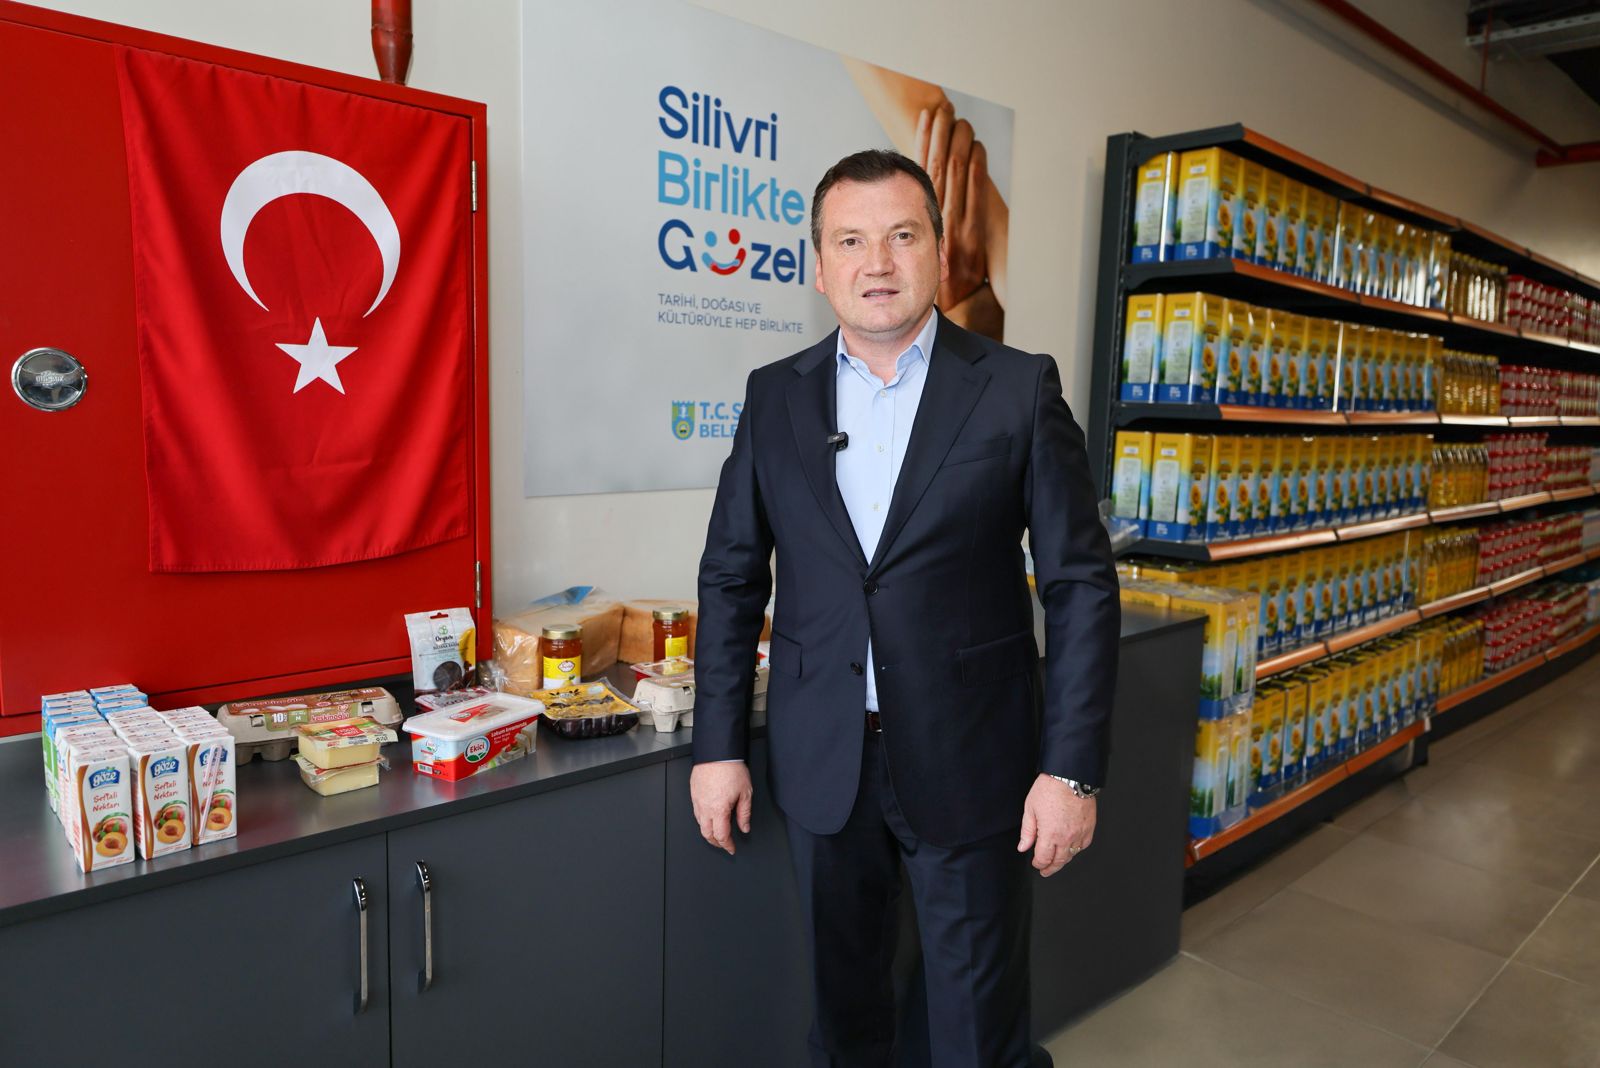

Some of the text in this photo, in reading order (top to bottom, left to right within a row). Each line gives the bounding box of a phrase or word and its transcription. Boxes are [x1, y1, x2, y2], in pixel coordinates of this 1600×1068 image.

[658, 85, 778, 161] Silivri
[658, 150, 805, 225] Birlikte
[658, 219, 805, 285] Güzel
[701, 297, 745, 313] DOĞASI
[747, 303, 762, 314] VE
[657, 309, 803, 334] KÜLTÜRÜYLE HEP BİRLİKTE
[699, 402, 742, 420] T.C. S
[699, 424, 737, 438] BELE
[272, 712, 284, 723] 10
[469, 742, 485, 753] Ekici
